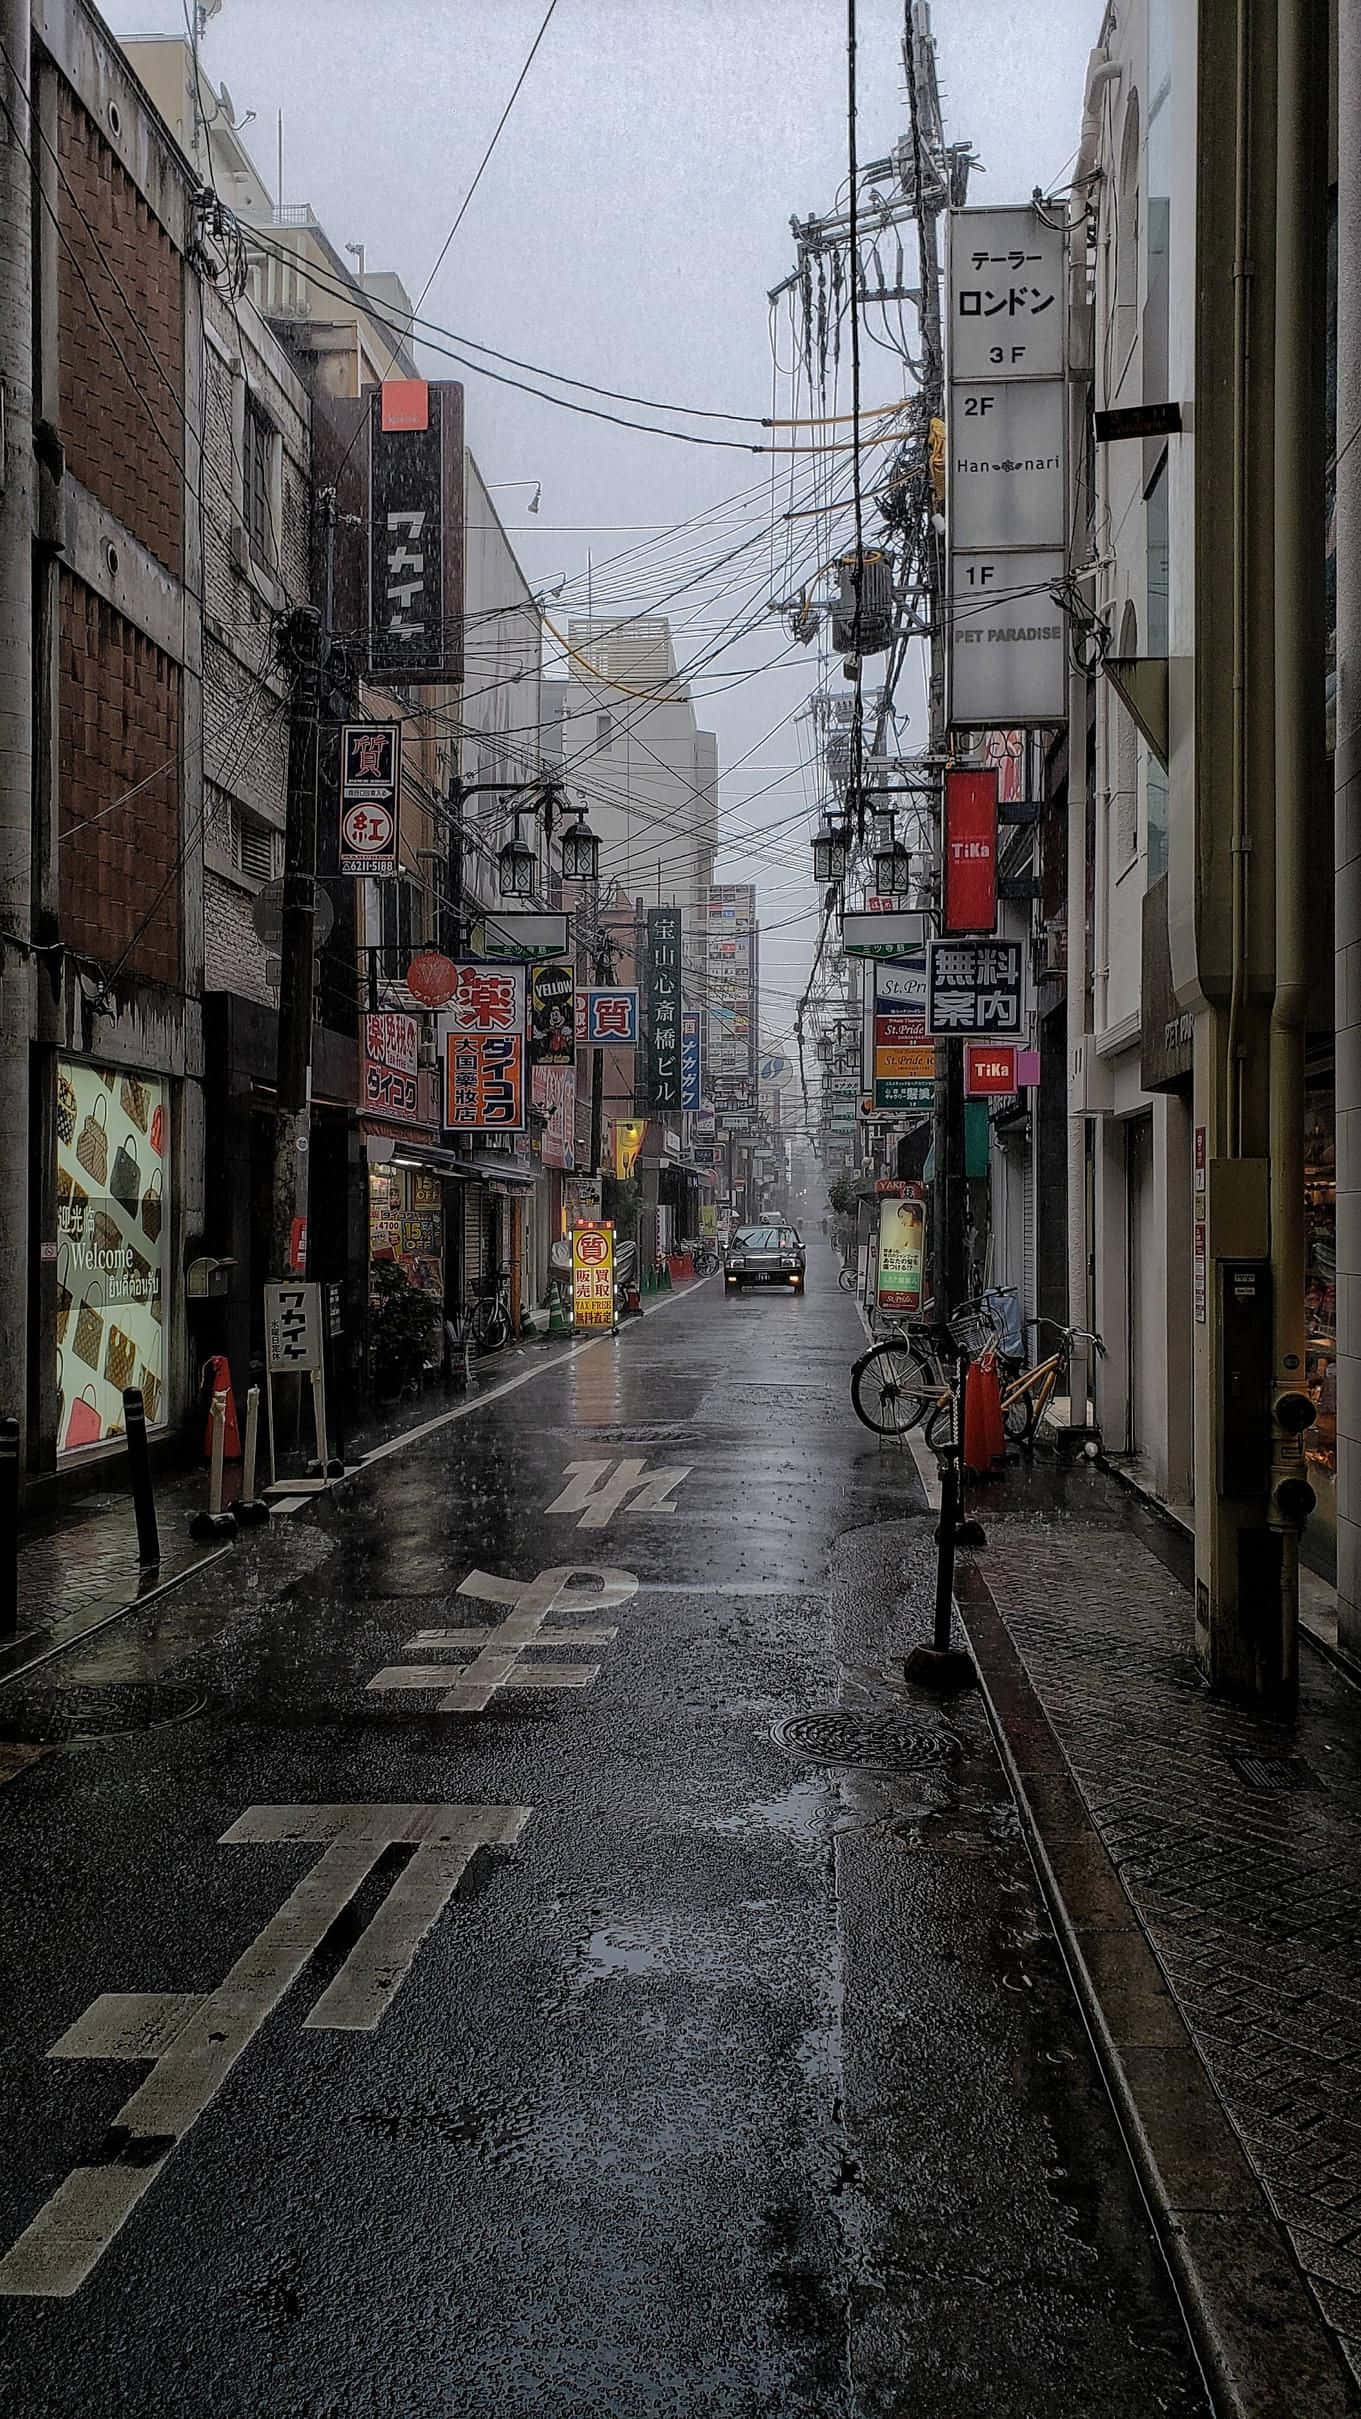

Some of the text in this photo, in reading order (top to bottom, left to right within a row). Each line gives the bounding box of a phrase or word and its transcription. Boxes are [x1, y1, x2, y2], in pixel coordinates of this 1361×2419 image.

[971, 251, 1042, 271] テーラー
[959, 286, 1055, 317] ロンドン
[964, 397, 995, 416] 2F
[965, 566, 995, 585] 1F
[954, 626, 1061, 643] PET PARADISE
[351, 733, 390, 778] 質
[351, 810, 385, 844] 紅
[951, 842, 990, 859] TiKa
[934, 948, 1019, 986] 無料
[453, 966, 516, 1031] 薬
[535, 979, 573, 998] YELLOW
[593, 997, 632, 1041] 質
[653, 918, 677, 1102] 宝山心斎橋ビル
[933, 990, 1018, 1027] 案内
[481, 1037, 516, 1125] ダイコク
[974, 1063, 1010, 1077] TiKa
[367, 1063, 417, 1112] ダイコク
[71, 1241, 134, 1272] Welcome
[580, 1237, 604, 1261] 質
[575, 1268, 591, 1298] 販売
[595, 1268, 610, 1297] 買取
